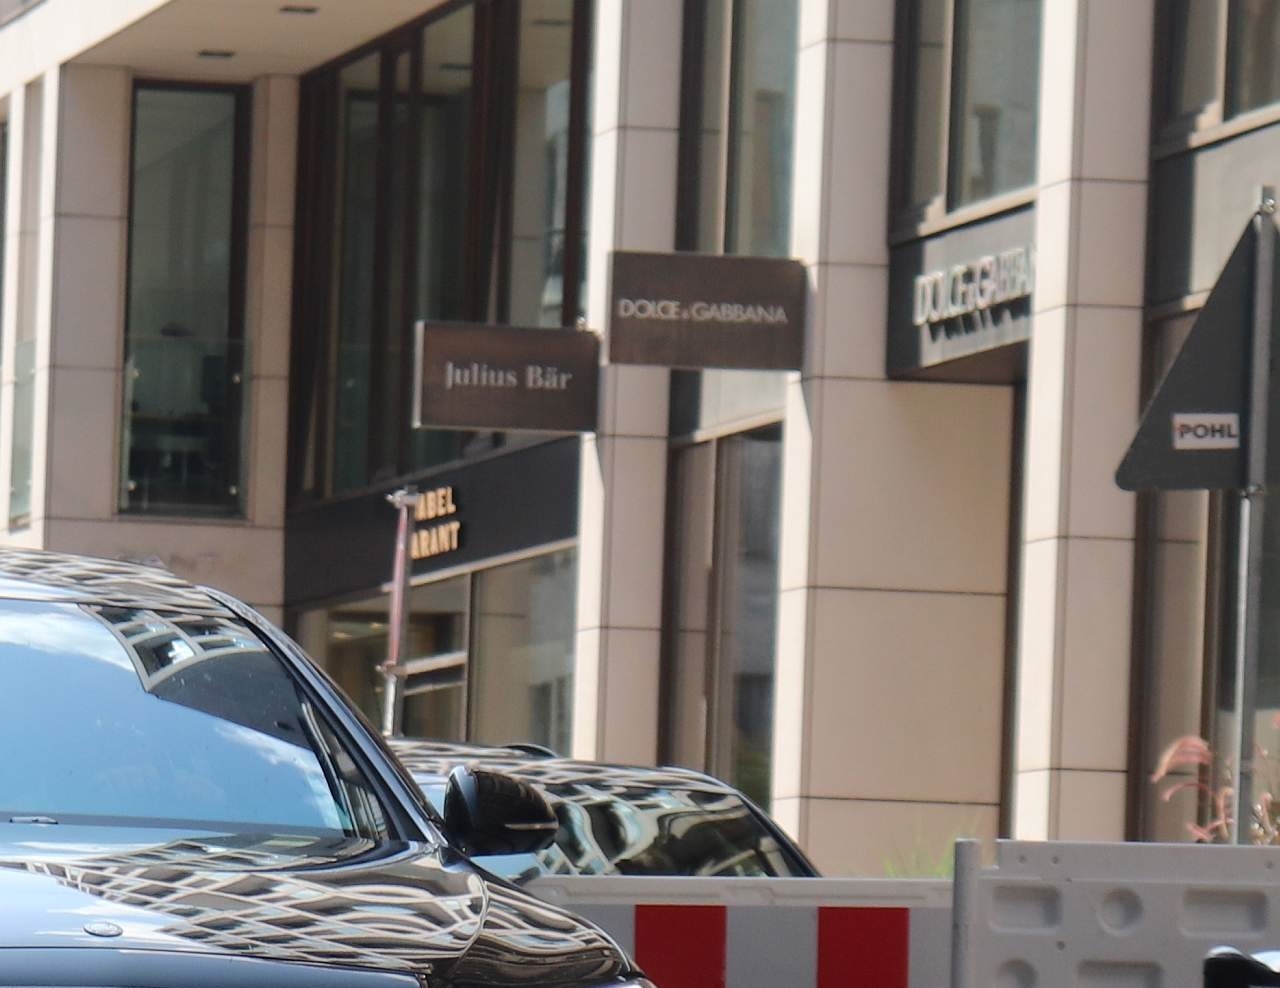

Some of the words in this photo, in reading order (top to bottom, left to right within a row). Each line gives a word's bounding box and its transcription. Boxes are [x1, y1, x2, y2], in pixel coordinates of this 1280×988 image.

[445, 361, 517, 390] Julius
[525, 364, 573, 391] Bär
[1178, 422, 1238, 440] POHL
[415, 486, 457, 521] ABEL
[410, 521, 461, 560] ARANT
